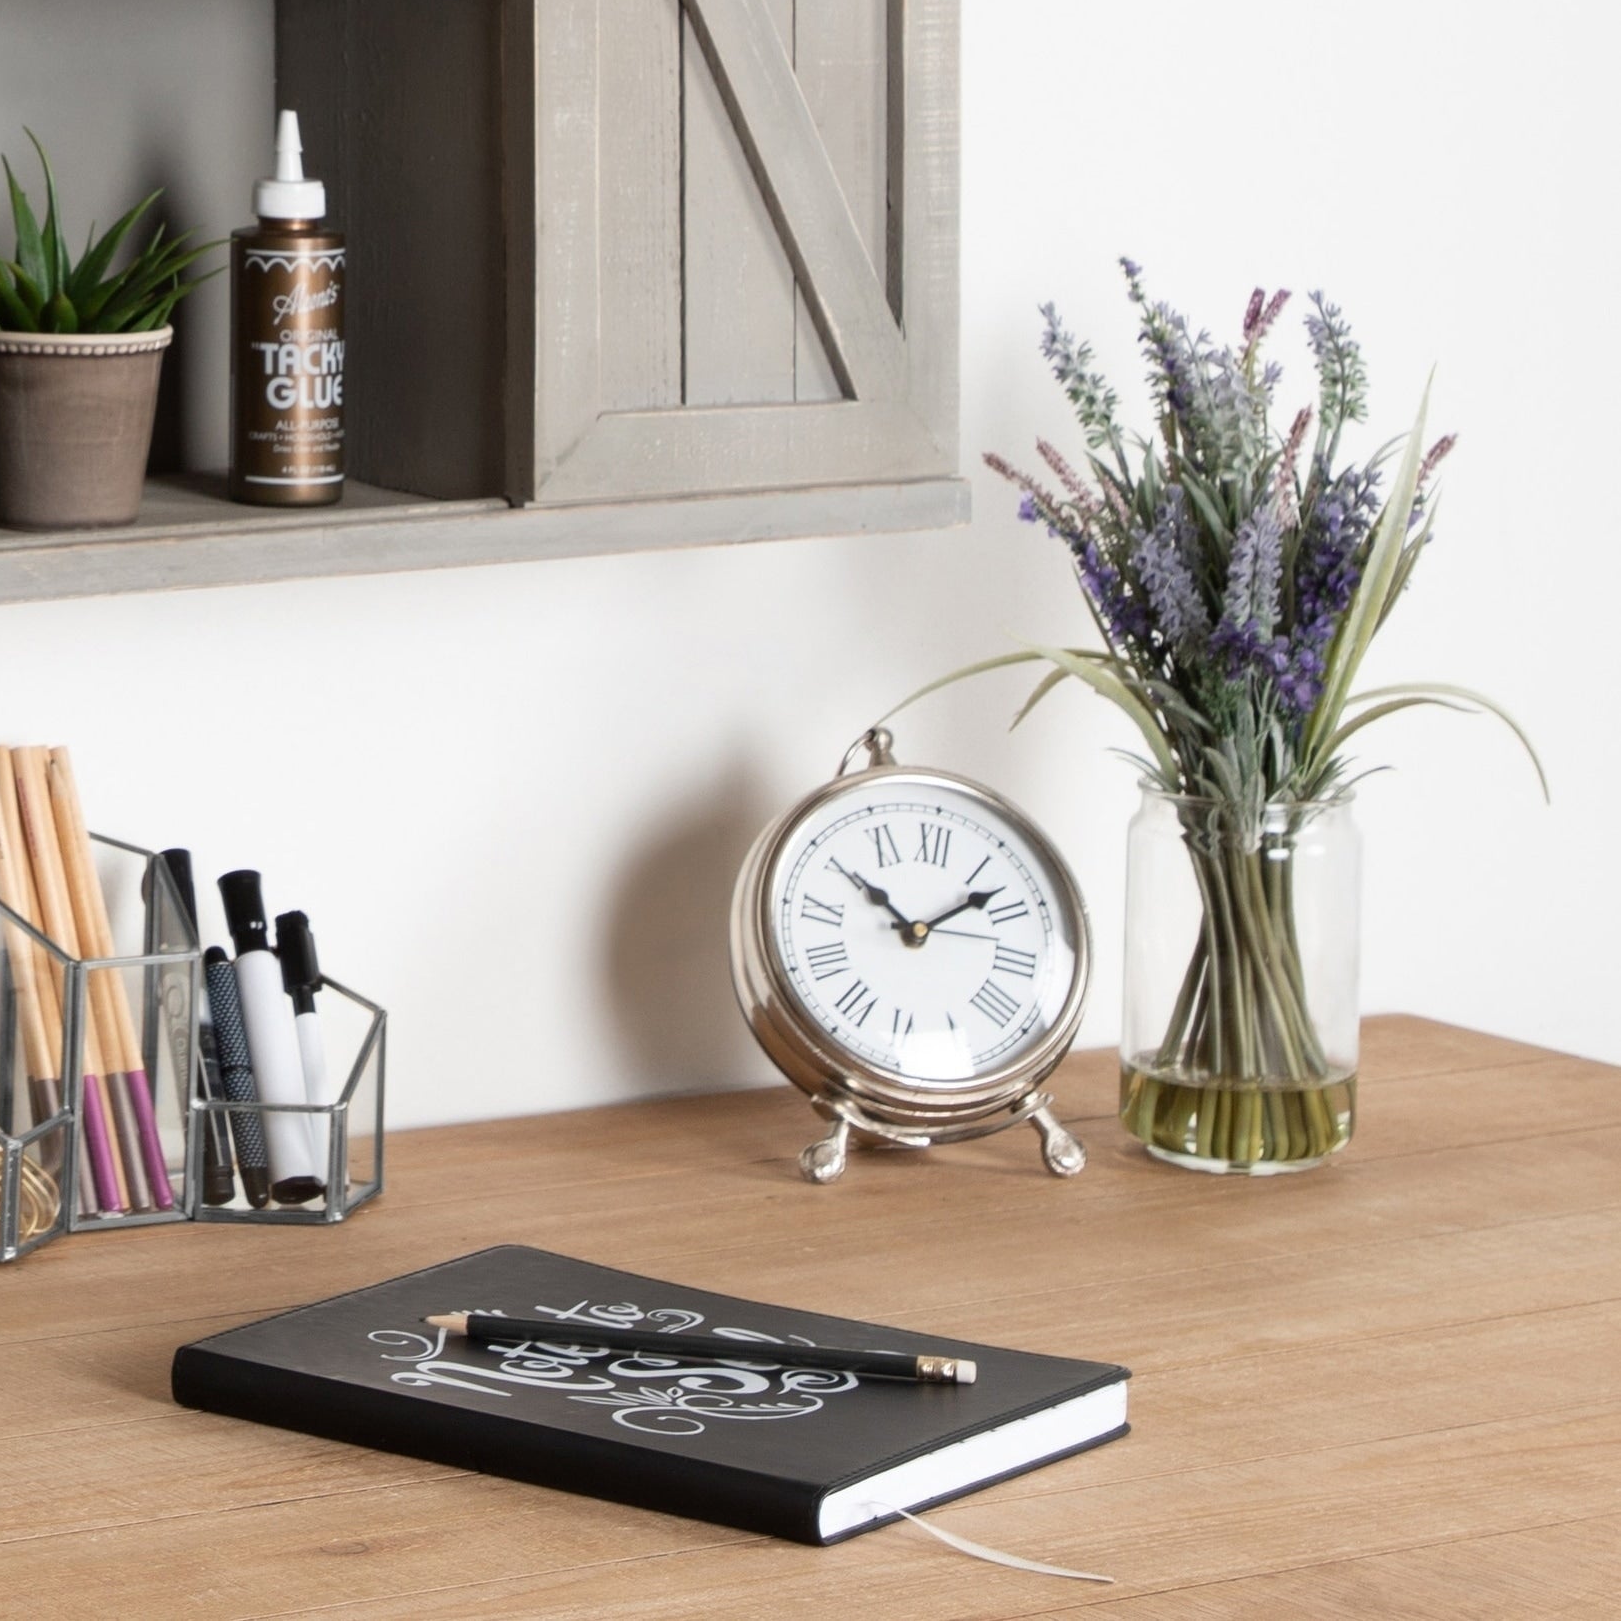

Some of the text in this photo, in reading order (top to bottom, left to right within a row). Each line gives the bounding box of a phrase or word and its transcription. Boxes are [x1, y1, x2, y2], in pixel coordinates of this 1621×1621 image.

[266, 374, 343, 410] GLUE
[866, 825, 901, 868] XI
[915, 823, 952, 868] XII
[965, 855, 992, 885] I
[801, 893, 844, 927] IX
[988, 900, 1029, 925] II
[806, 941, 850, 981] VIII
[993, 944, 1036, 979] III
[835, 979, 879, 1027] VII
[535, 1300, 645, 1329] to
